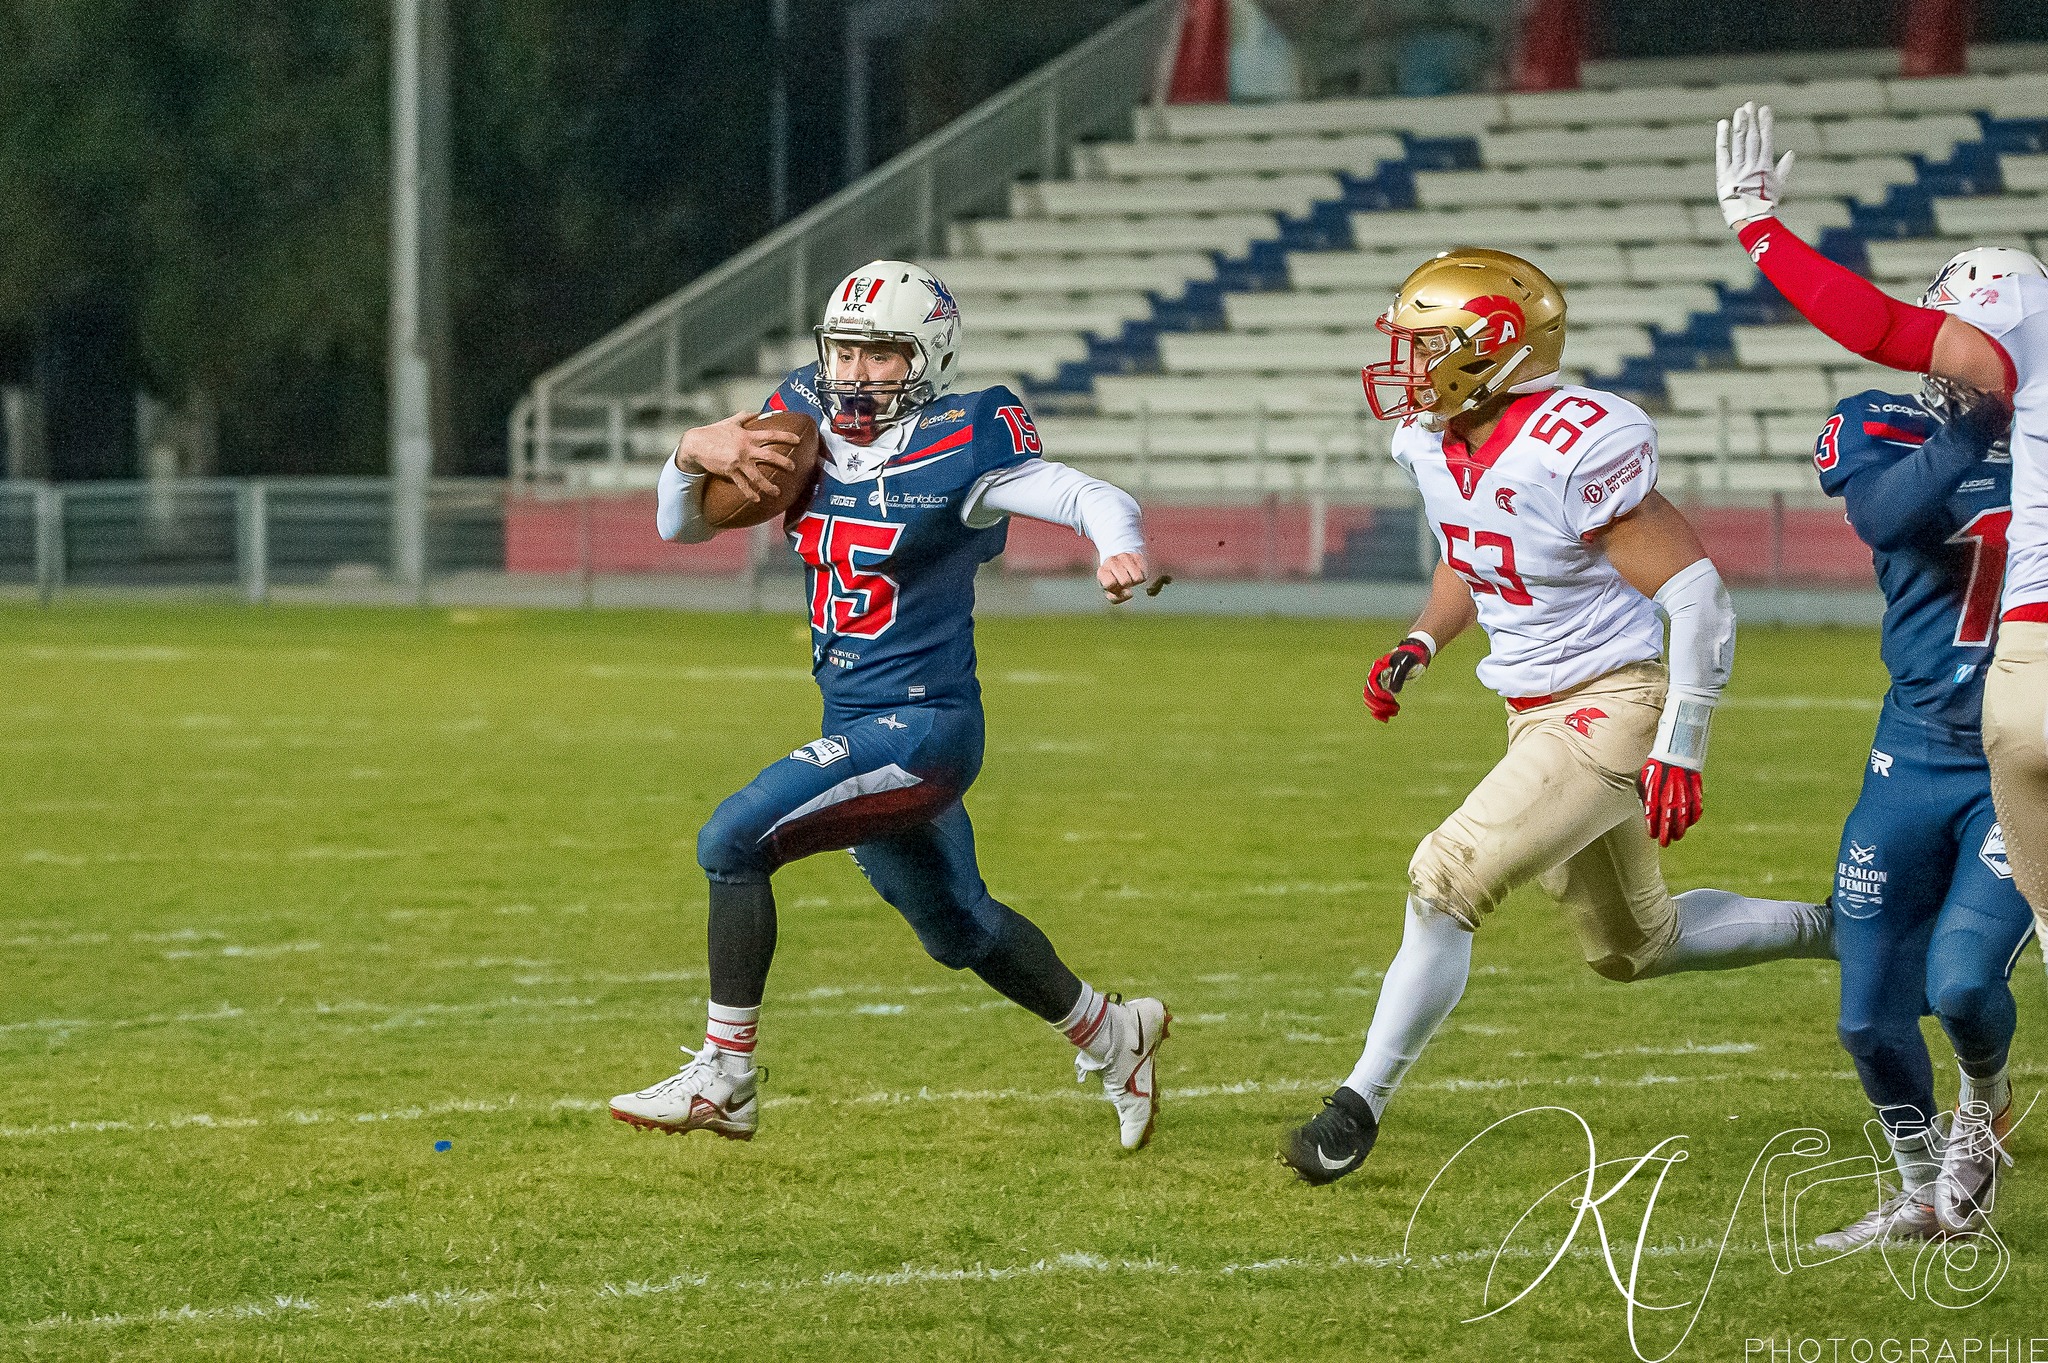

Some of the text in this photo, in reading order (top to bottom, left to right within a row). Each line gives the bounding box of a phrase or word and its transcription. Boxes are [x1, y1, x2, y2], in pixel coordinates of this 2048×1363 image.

[843, 303, 867, 313] KFC
[994, 405, 1042, 455] 15
[1529, 396, 1608, 454] 53
[1604, 457, 1640, 487] BOUCHES
[885, 492, 949, 504] La Tentation
[1609, 482, 1620, 494] DU
[789, 511, 907, 640] 15
[1439, 521, 1534, 607] 53
[1838, 862, 1888, 883] LE SALON
